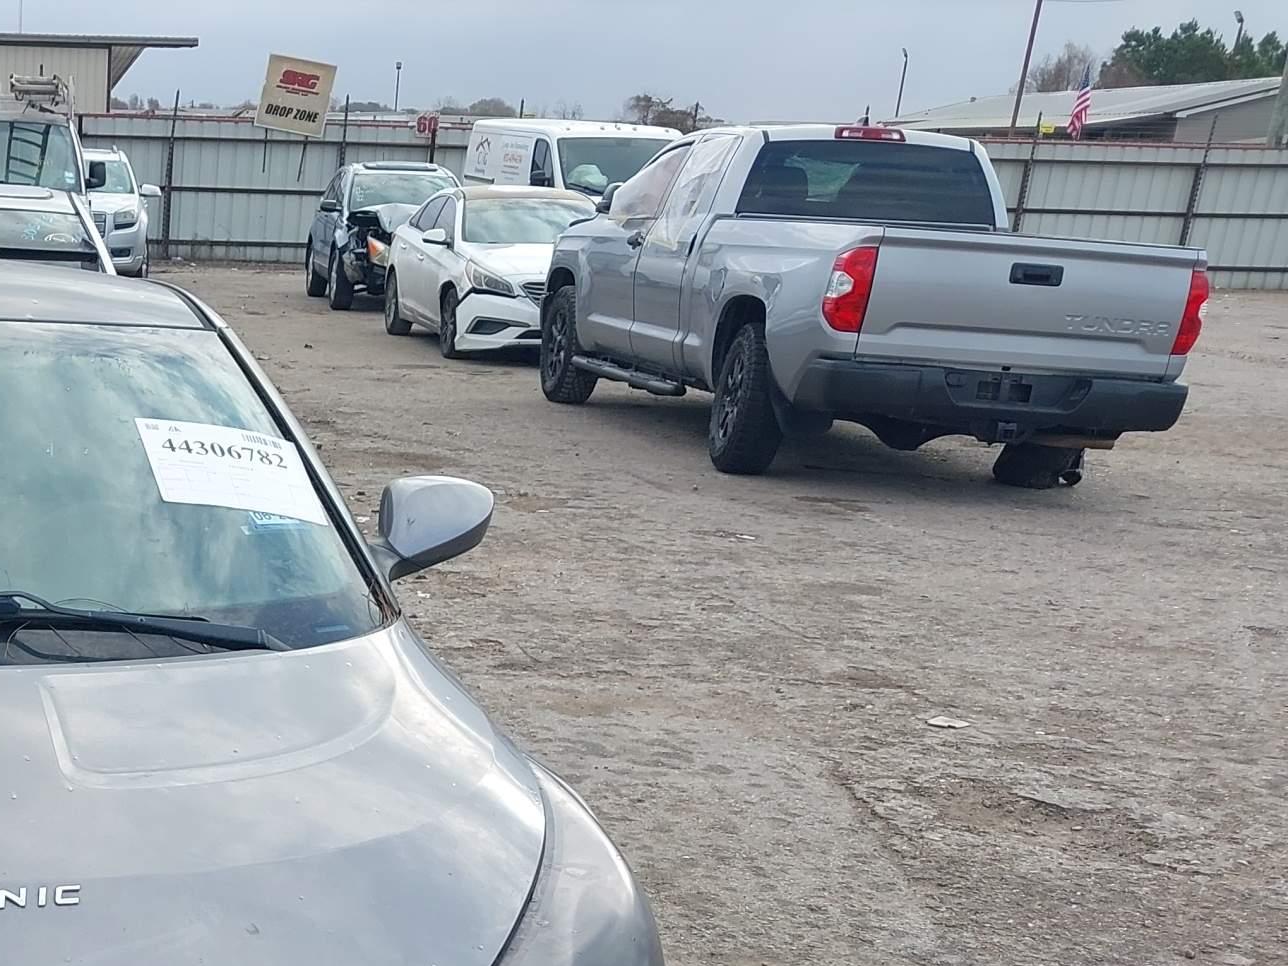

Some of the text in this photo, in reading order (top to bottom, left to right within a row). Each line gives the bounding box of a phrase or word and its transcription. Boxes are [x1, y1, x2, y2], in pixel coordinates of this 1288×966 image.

[264, 103, 320, 123] DROP ZONE
[1064, 313, 1172, 337] TUNDRA
[162, 437, 288, 469] 44306782
